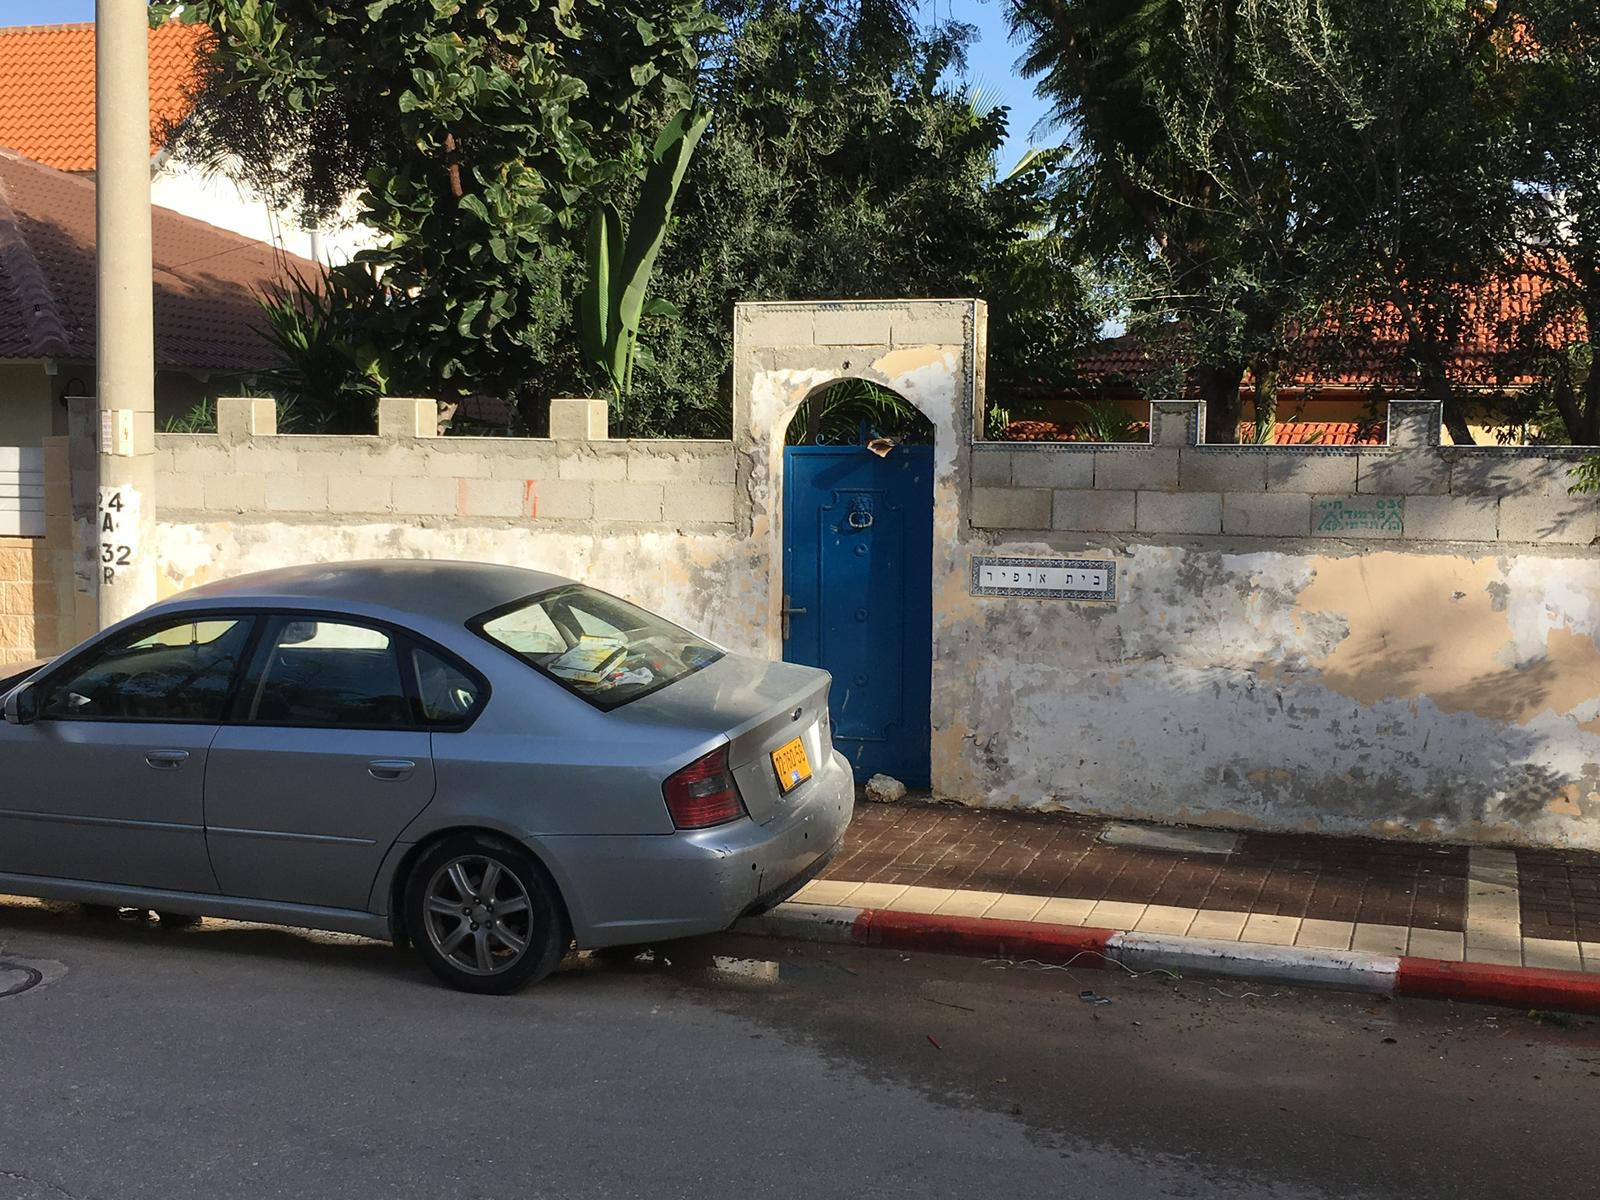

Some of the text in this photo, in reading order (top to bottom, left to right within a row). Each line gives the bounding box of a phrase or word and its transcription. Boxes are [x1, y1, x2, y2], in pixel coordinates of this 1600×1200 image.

[102, 512, 114, 532] A
[102, 543, 131, 565] 32
[104, 566, 115, 584] R
[986, 571, 1101, 586] בית אופיר
